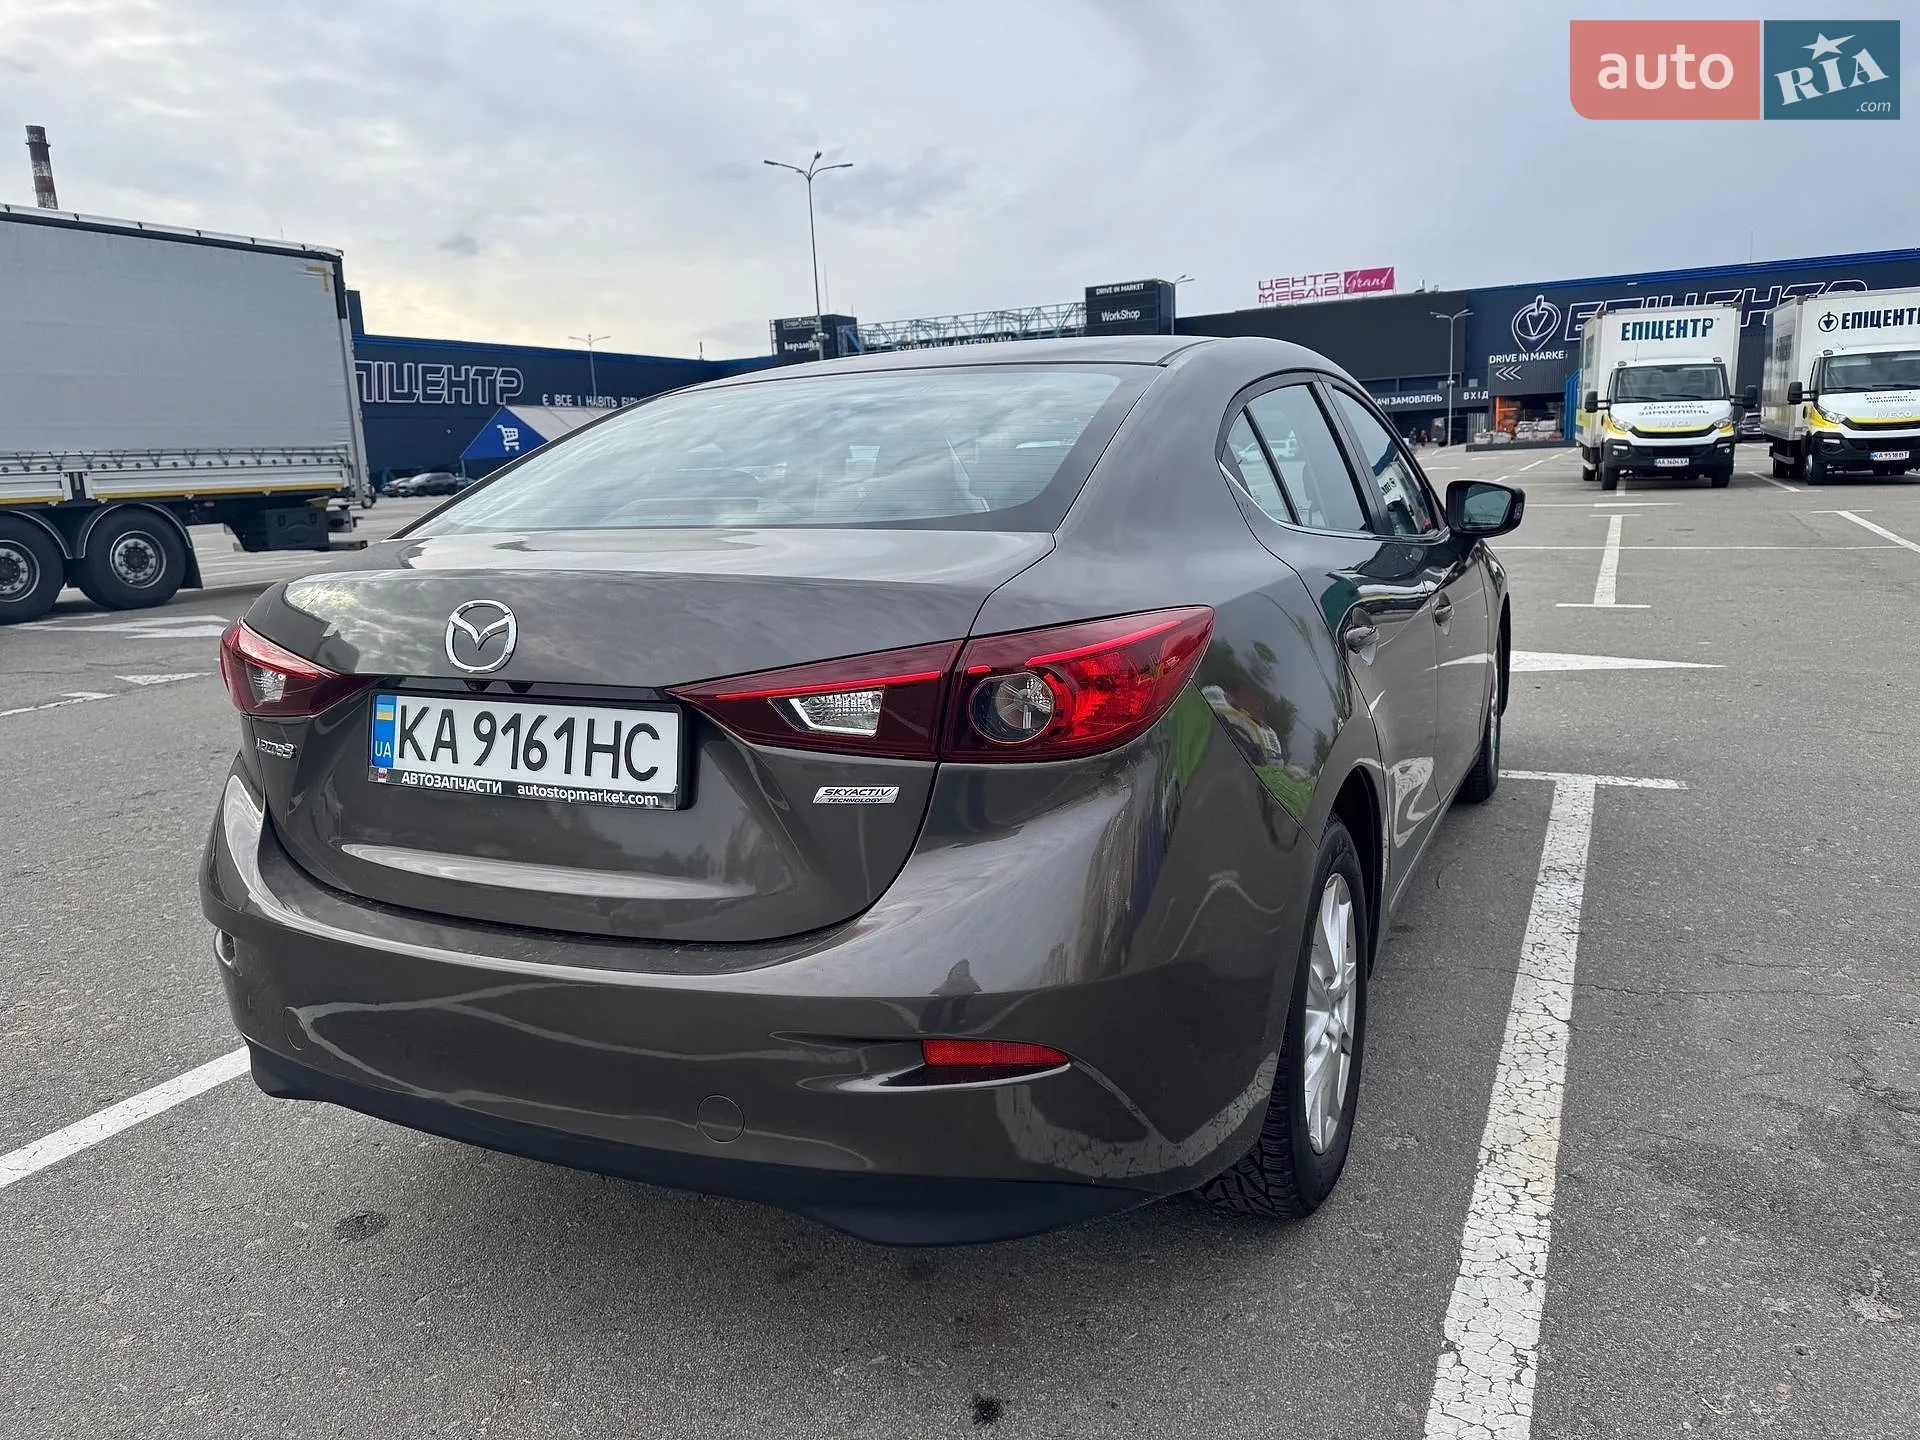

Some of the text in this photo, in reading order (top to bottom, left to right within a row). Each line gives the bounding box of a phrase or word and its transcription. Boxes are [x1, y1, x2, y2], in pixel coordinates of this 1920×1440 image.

[1258, 272, 1340, 291] ЦЕНТР
[1345, 268, 1392, 290] Grand
[1095, 288, 1113, 296] DRIVE
[1121, 283, 1145, 292] MARKET
[1258, 285, 1340, 303] МЕБЛІВ
[1101, 309, 1141, 322] WorkShop
[1841, 306, 1920, 330] ЕПІЦЕНТ
[1621, 317, 1714, 341] ЕПІЦЕНТР
[1489, 353, 1517, 364] DRIVE
[1519, 352, 1529, 362] IN
[554, 394, 573, 407] ВСЕ
[1373, 394, 1443, 407] АЧІ ЗАМОВЛЕНЬ
[1463, 391, 1489, 400] ВХІД
[399, 705, 459, 764] KA
[375, 741, 392, 758] UA
[401, 771, 503, 794] АВТОЗАПЧАСТИ
[517, 783, 659, 806] autostopmarket.com
[822, 788, 892, 796] SKYACTIV
